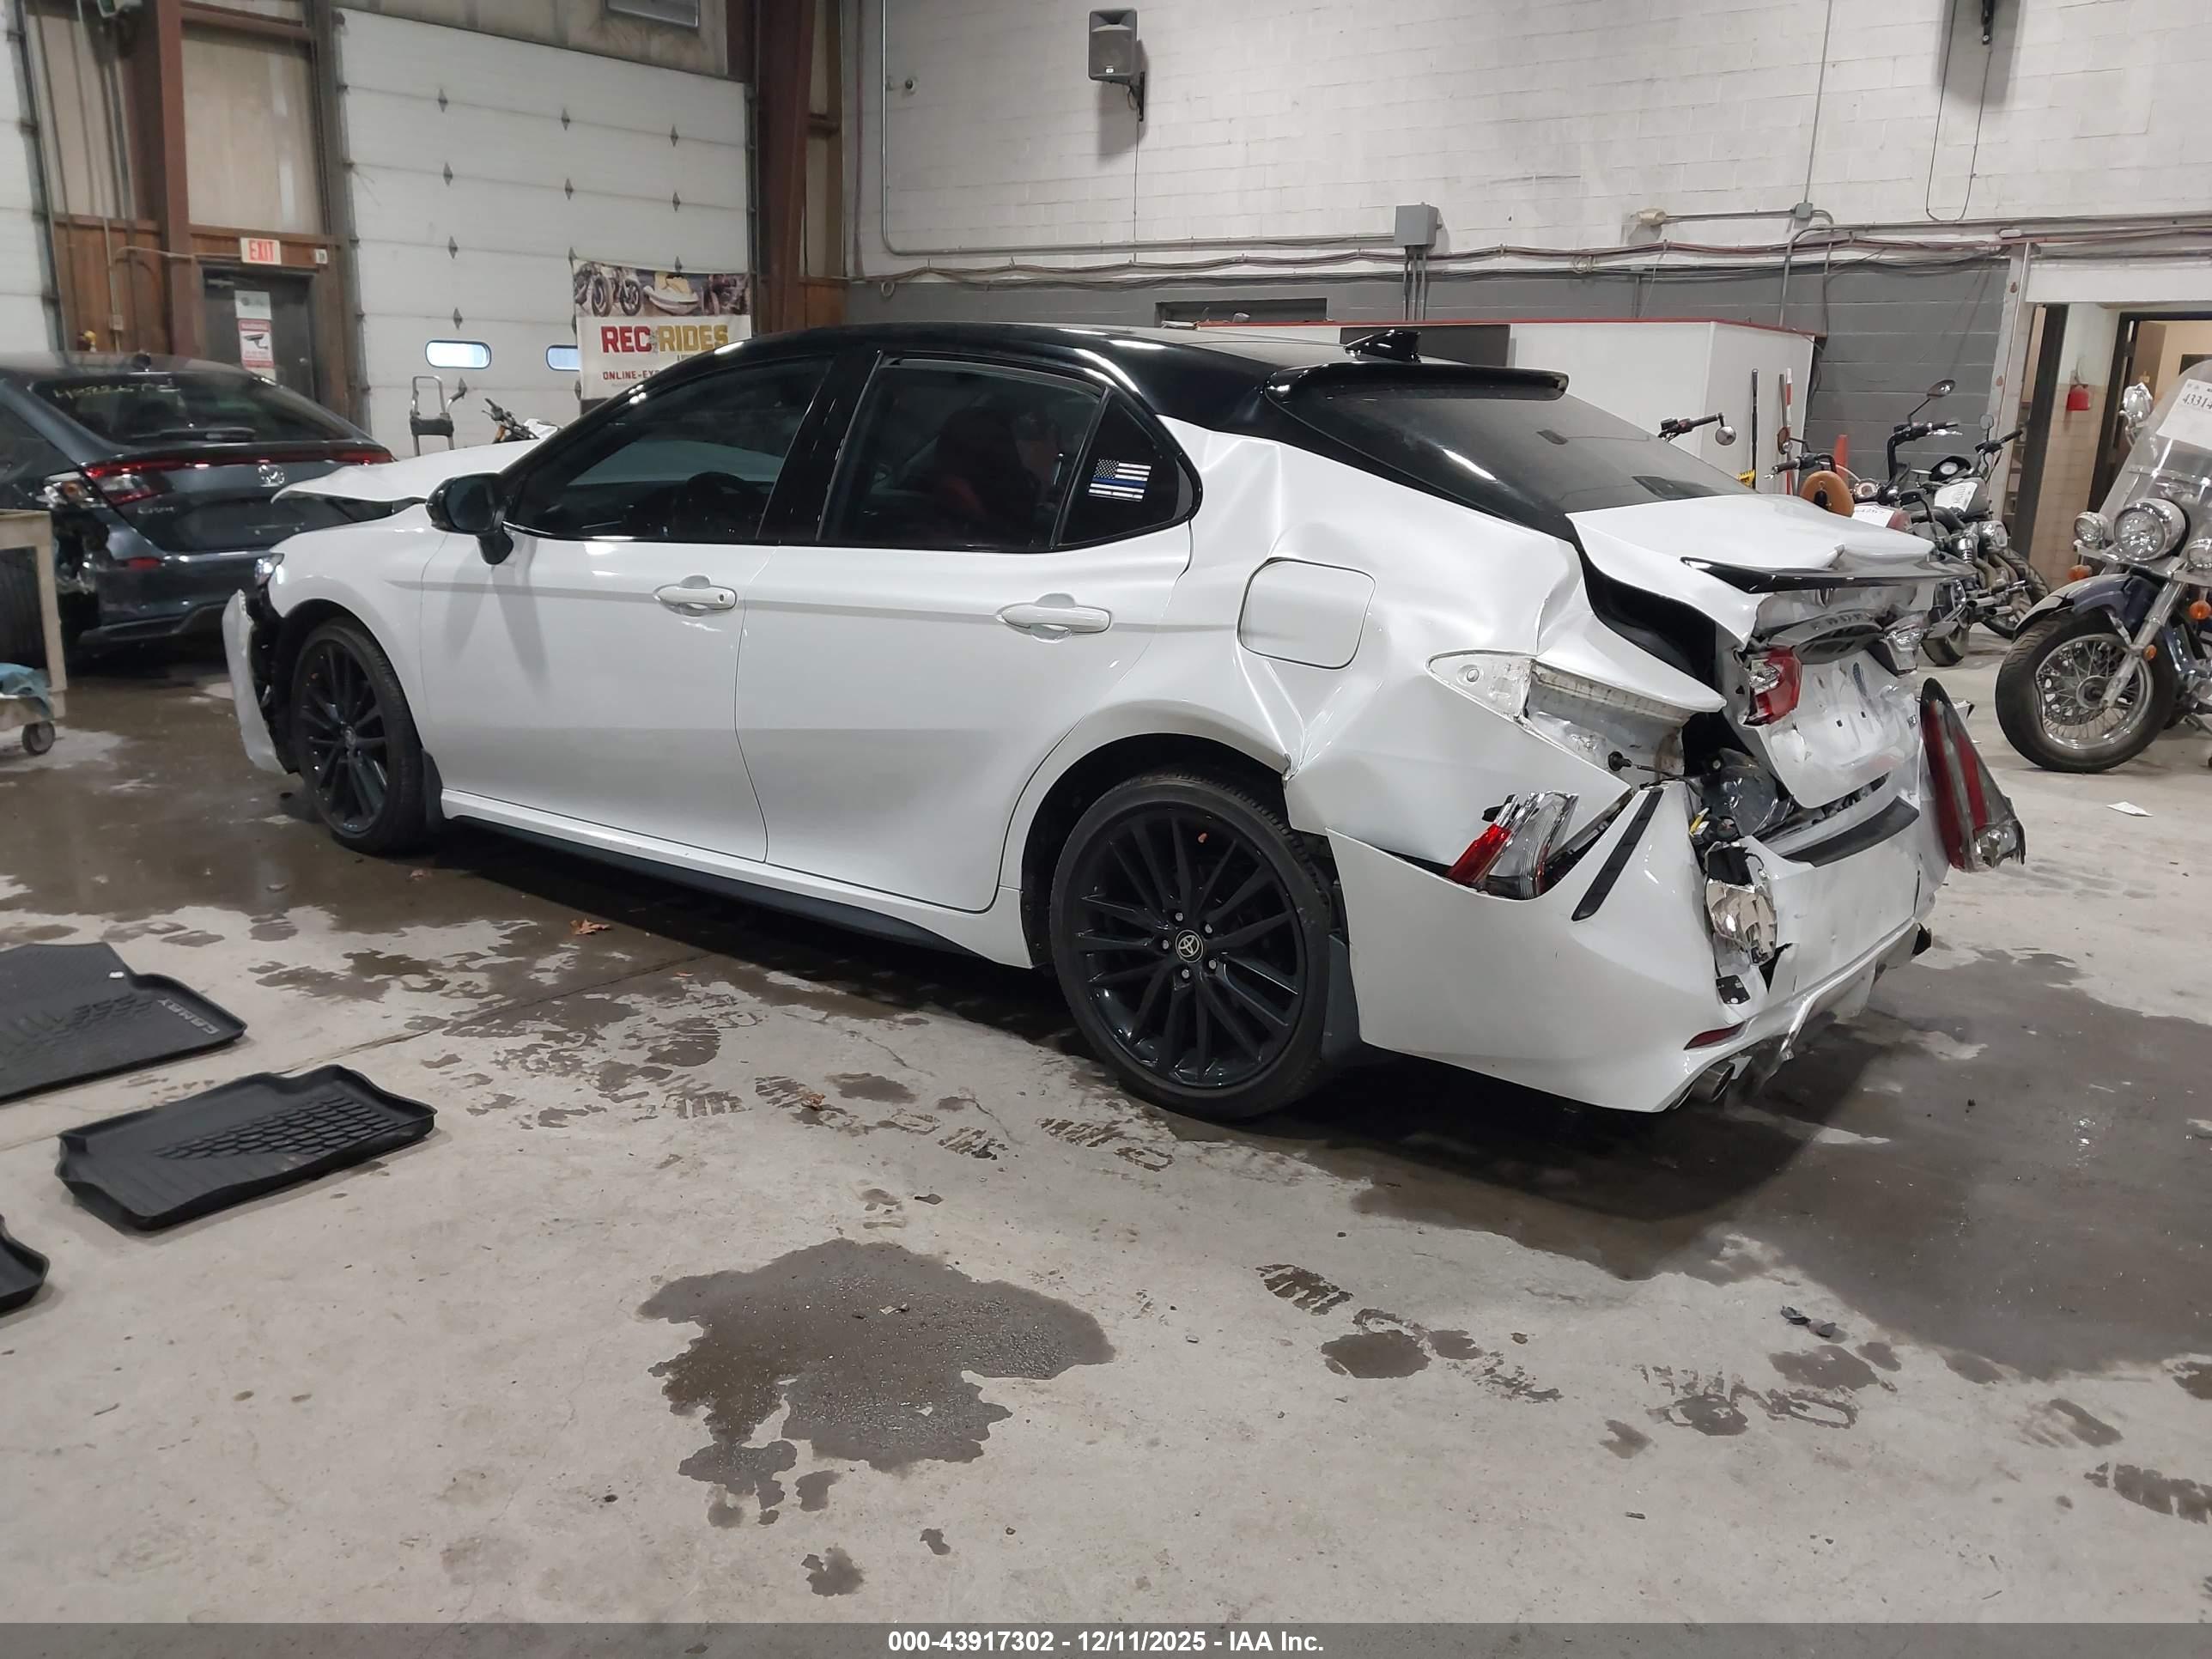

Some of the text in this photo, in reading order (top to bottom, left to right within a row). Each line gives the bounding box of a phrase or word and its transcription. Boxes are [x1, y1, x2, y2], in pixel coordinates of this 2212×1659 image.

[249, 240, 274, 261] EXIT
[601, 325, 728, 353] REC RIDES
[603, 370, 660, 380] ONLINE-EX
[157, 999, 221, 1036] CAMRY
